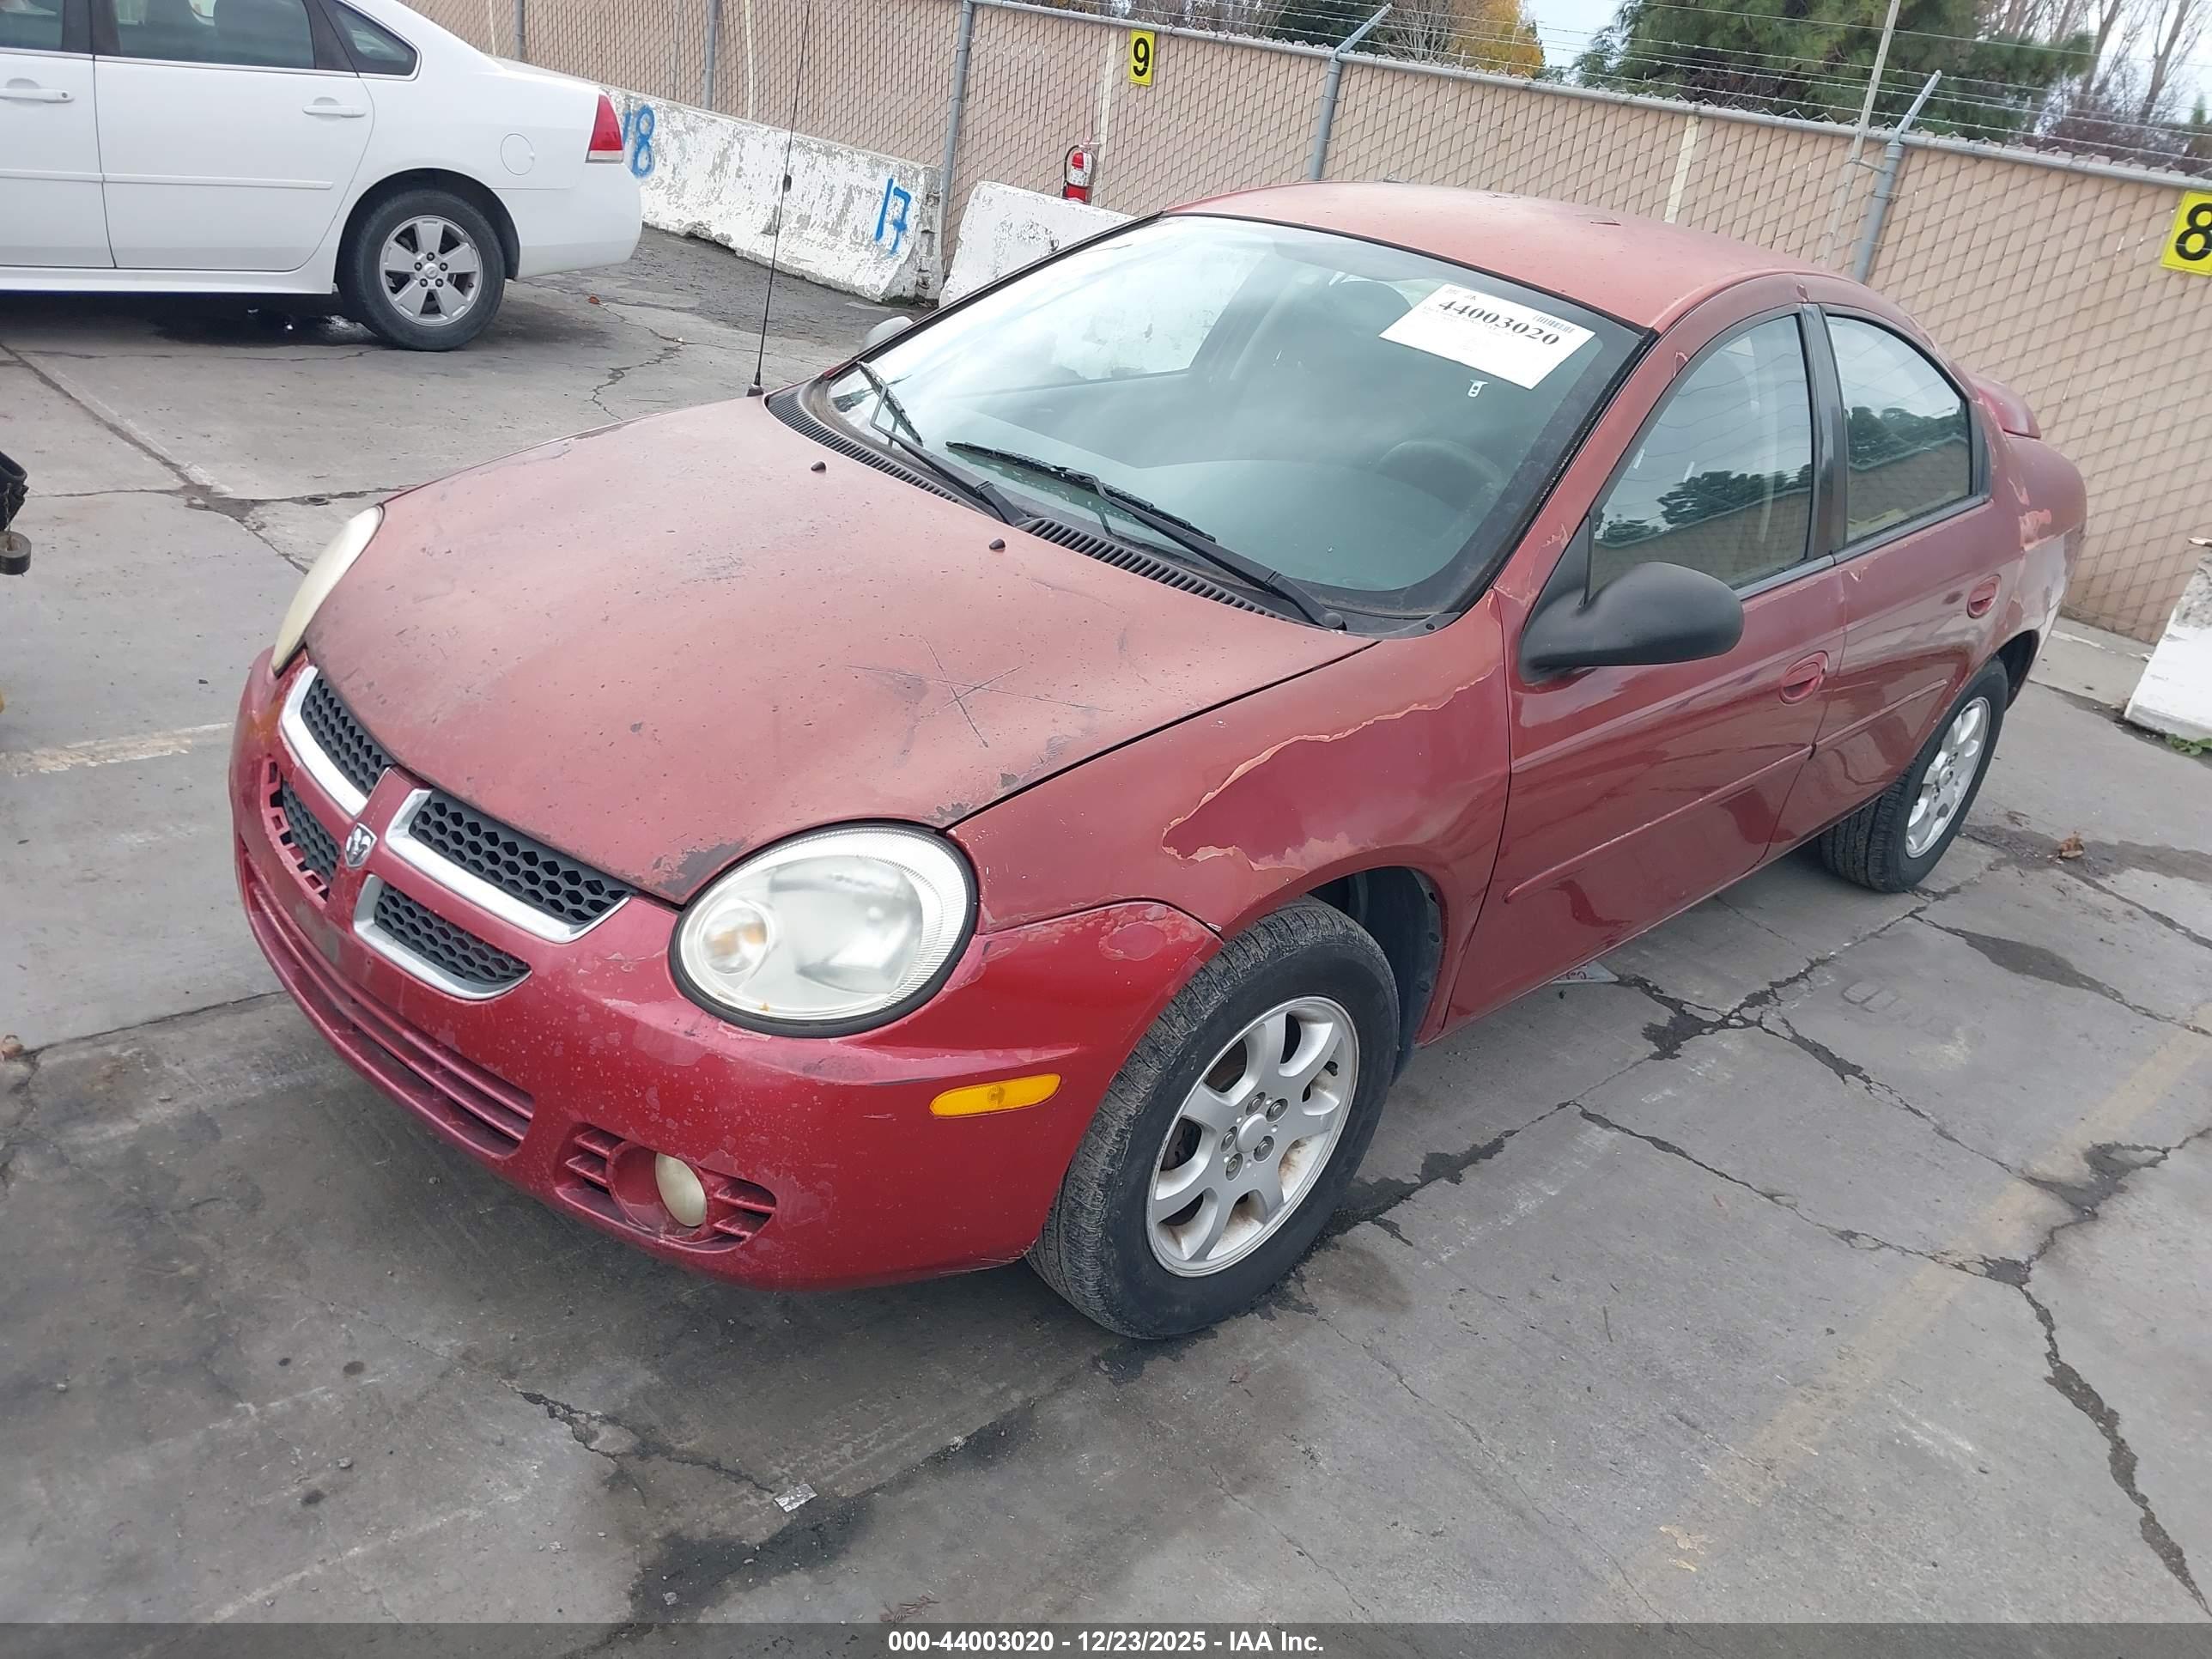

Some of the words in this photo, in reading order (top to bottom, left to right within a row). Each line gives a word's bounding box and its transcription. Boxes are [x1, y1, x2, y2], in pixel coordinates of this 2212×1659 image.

[1133, 37, 1150, 77] 9
[876, 178, 912, 255] 17
[2175, 202, 2212, 261] 8
[1438, 300, 1560, 346] 44003020
